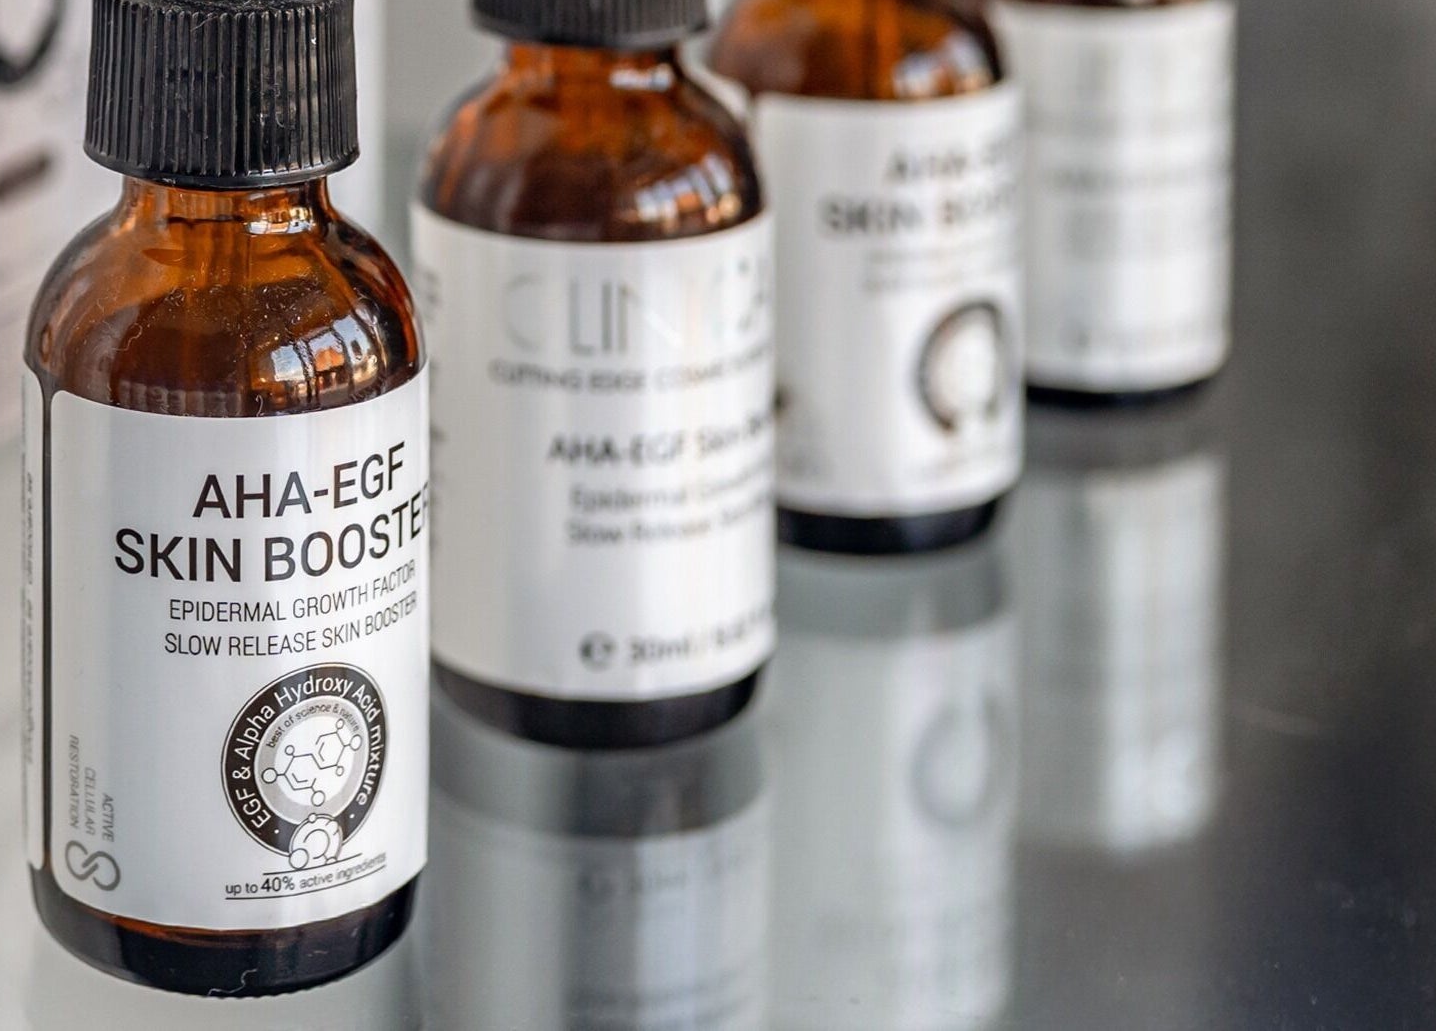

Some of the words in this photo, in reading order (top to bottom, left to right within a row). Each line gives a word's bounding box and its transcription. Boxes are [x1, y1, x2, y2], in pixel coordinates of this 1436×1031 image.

[547, 434, 685, 467] AHA-EGF
[193, 441, 405, 519] AHA-EGF
[114, 528, 242, 583] SKIN
[169, 599, 287, 622] EPIDERMAL
[292, 586, 368, 619] GROWTH
[372, 559, 416, 601] FACTOR
[164, 633, 222, 656] SLOW
[228, 630, 316, 656] RELEASE
[321, 620, 361, 649] SKIN
[365, 590, 417, 636] BOOSTER
[273, 675, 354, 708] Hydroxy
[351, 684, 380, 724] Acid
[233, 704, 275, 761] Alpha
[266, 727, 285, 749] best
[295, 704, 332, 720] science
[69, 735, 80, 830] RESTORATION
[232, 765, 252, 781] &
[355, 723, 386, 806] mixture
[83, 767, 97, 836] CELLULAR
[102, 793, 115, 842] ACTIVE
[235, 788, 272, 829] EGF
[225, 883, 242, 896] up
[245, 882, 258, 894] to
[260, 874, 296, 894] 40%
[299, 868, 333, 889] active
[335, 850, 387, 882] ingredients
